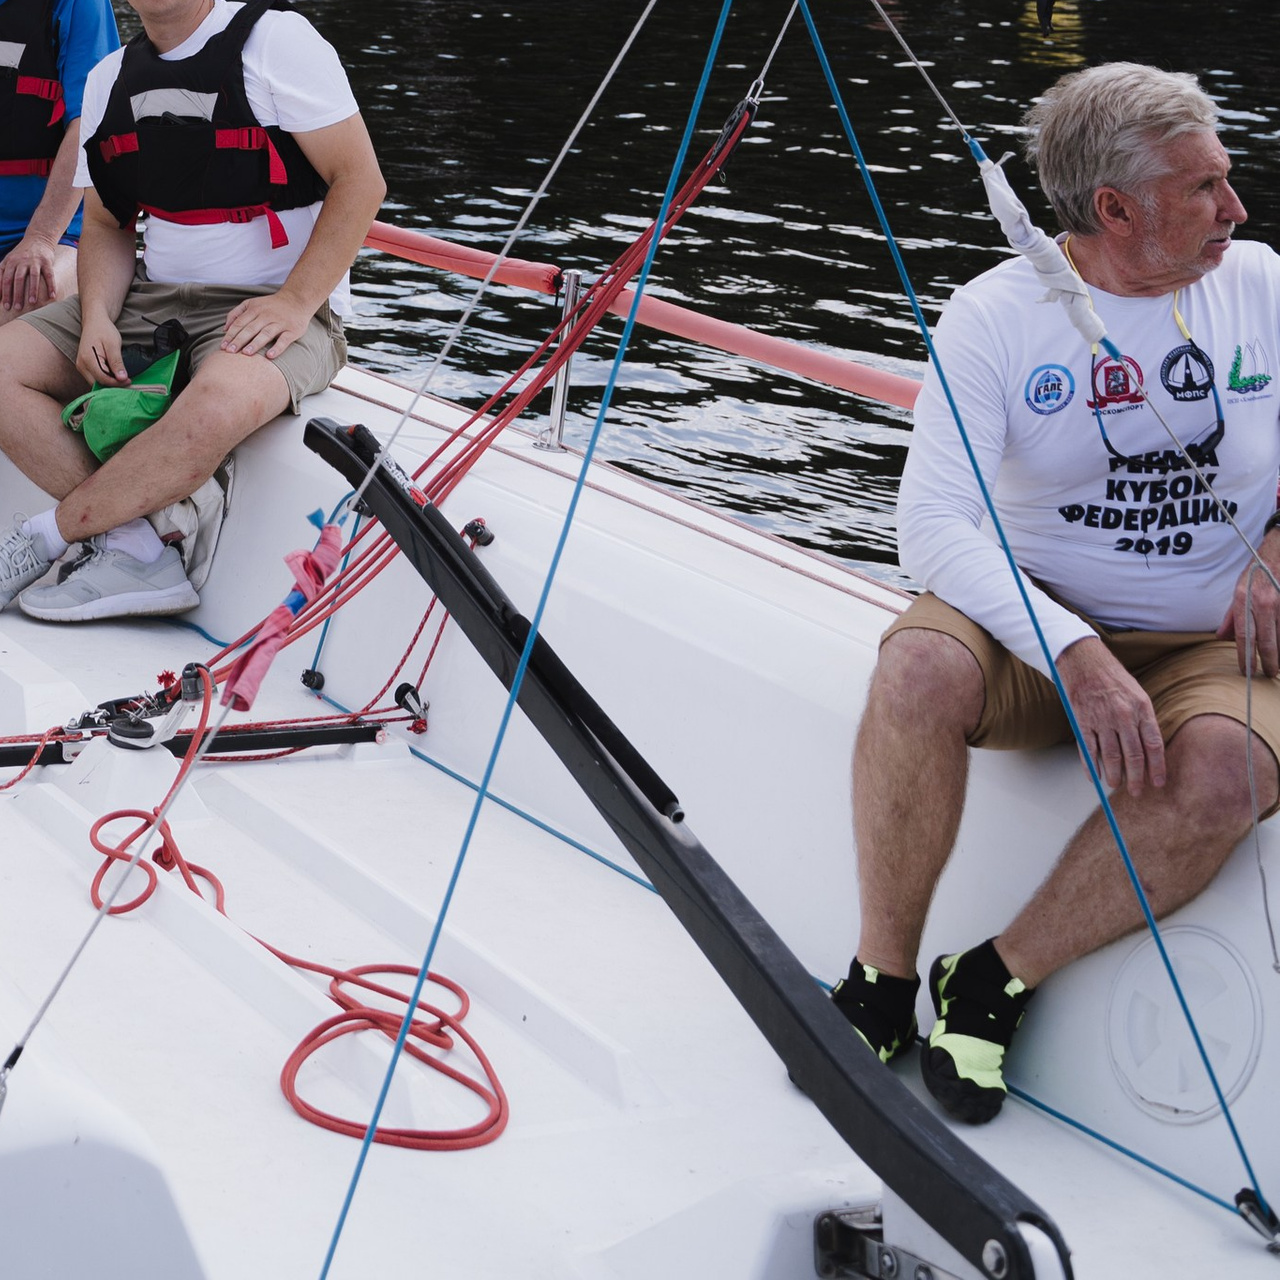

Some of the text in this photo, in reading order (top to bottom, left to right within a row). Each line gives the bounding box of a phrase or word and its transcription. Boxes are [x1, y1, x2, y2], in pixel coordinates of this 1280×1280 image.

[1176, 389, 1206, 399] МФПС
[1106, 473, 1218, 504] КУБОК
[1113, 531, 1193, 556] 2019
